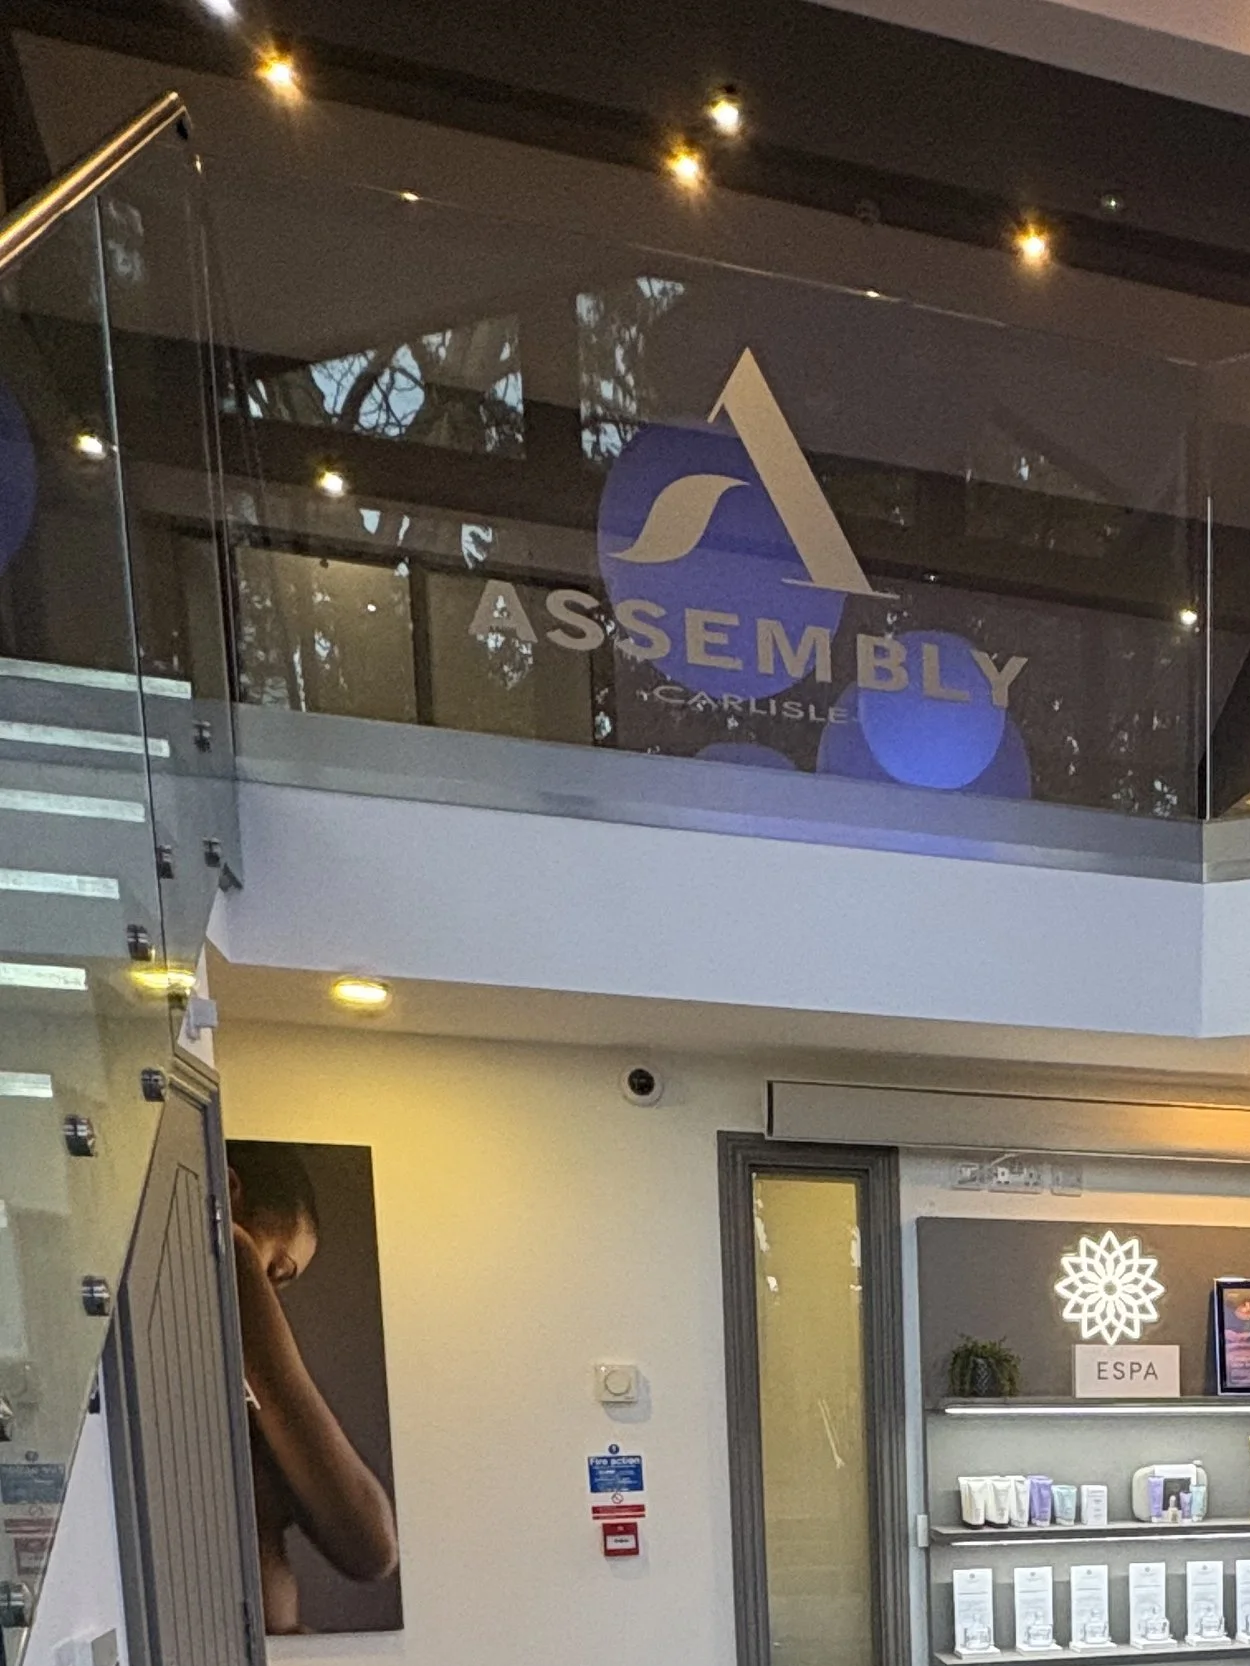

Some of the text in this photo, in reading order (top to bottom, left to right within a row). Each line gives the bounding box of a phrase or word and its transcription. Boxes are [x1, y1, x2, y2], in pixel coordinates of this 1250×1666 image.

[468, 579, 1029, 708] ASSEMBLY
[653, 684, 850, 724] CARLISLE
[1096, 1361, 1159, 1382] ESPA
[590, 1456, 641, 1466] Fire action
